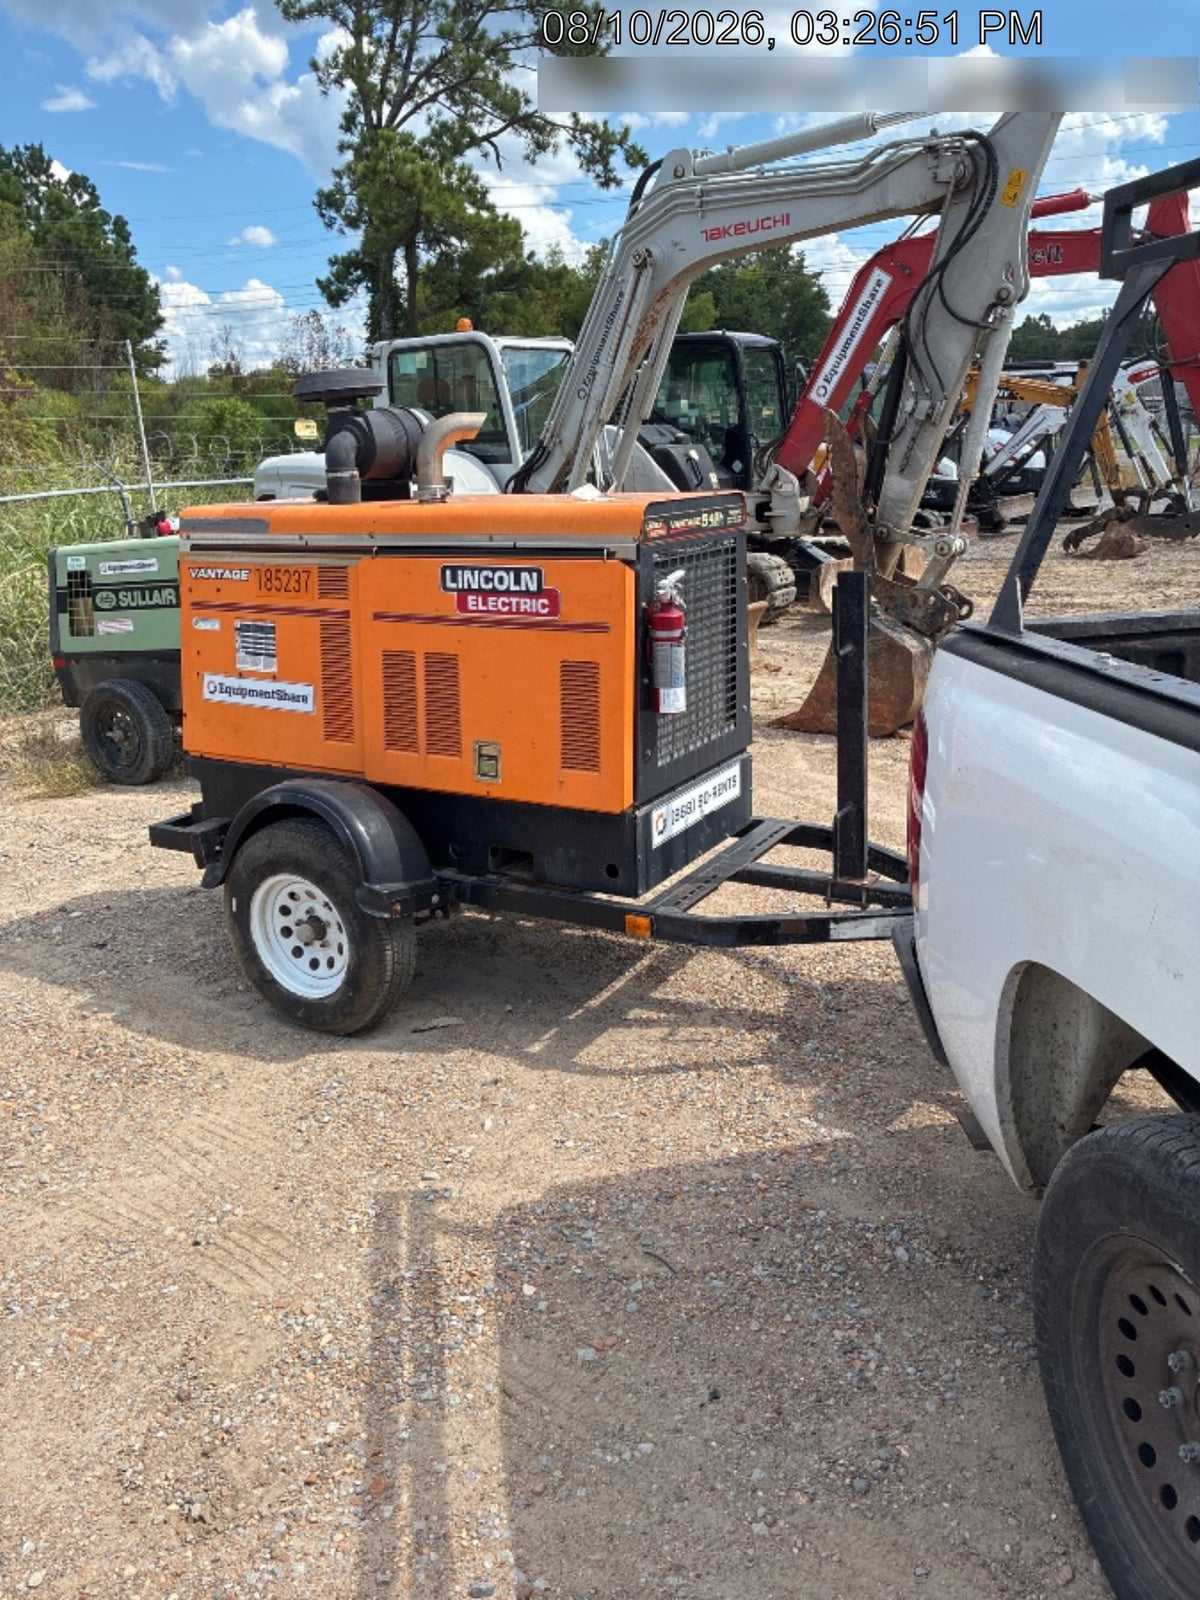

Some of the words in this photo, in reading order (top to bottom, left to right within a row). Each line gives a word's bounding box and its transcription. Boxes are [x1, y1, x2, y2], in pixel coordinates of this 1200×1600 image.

[1028, 243, 1062, 265] elt
[583, 290, 625, 387] EquipmentShare
[822, 277, 884, 384] EquipmentShare
[188, 568, 250, 582] VANTAGE
[256, 568, 312, 594] 185237
[445, 569, 538, 592] LINCOLN
[119, 588, 177, 607] SULLAIR
[467, 595, 550, 614] ELECTRIC
[218, 682, 309, 704] EquipmentShare
